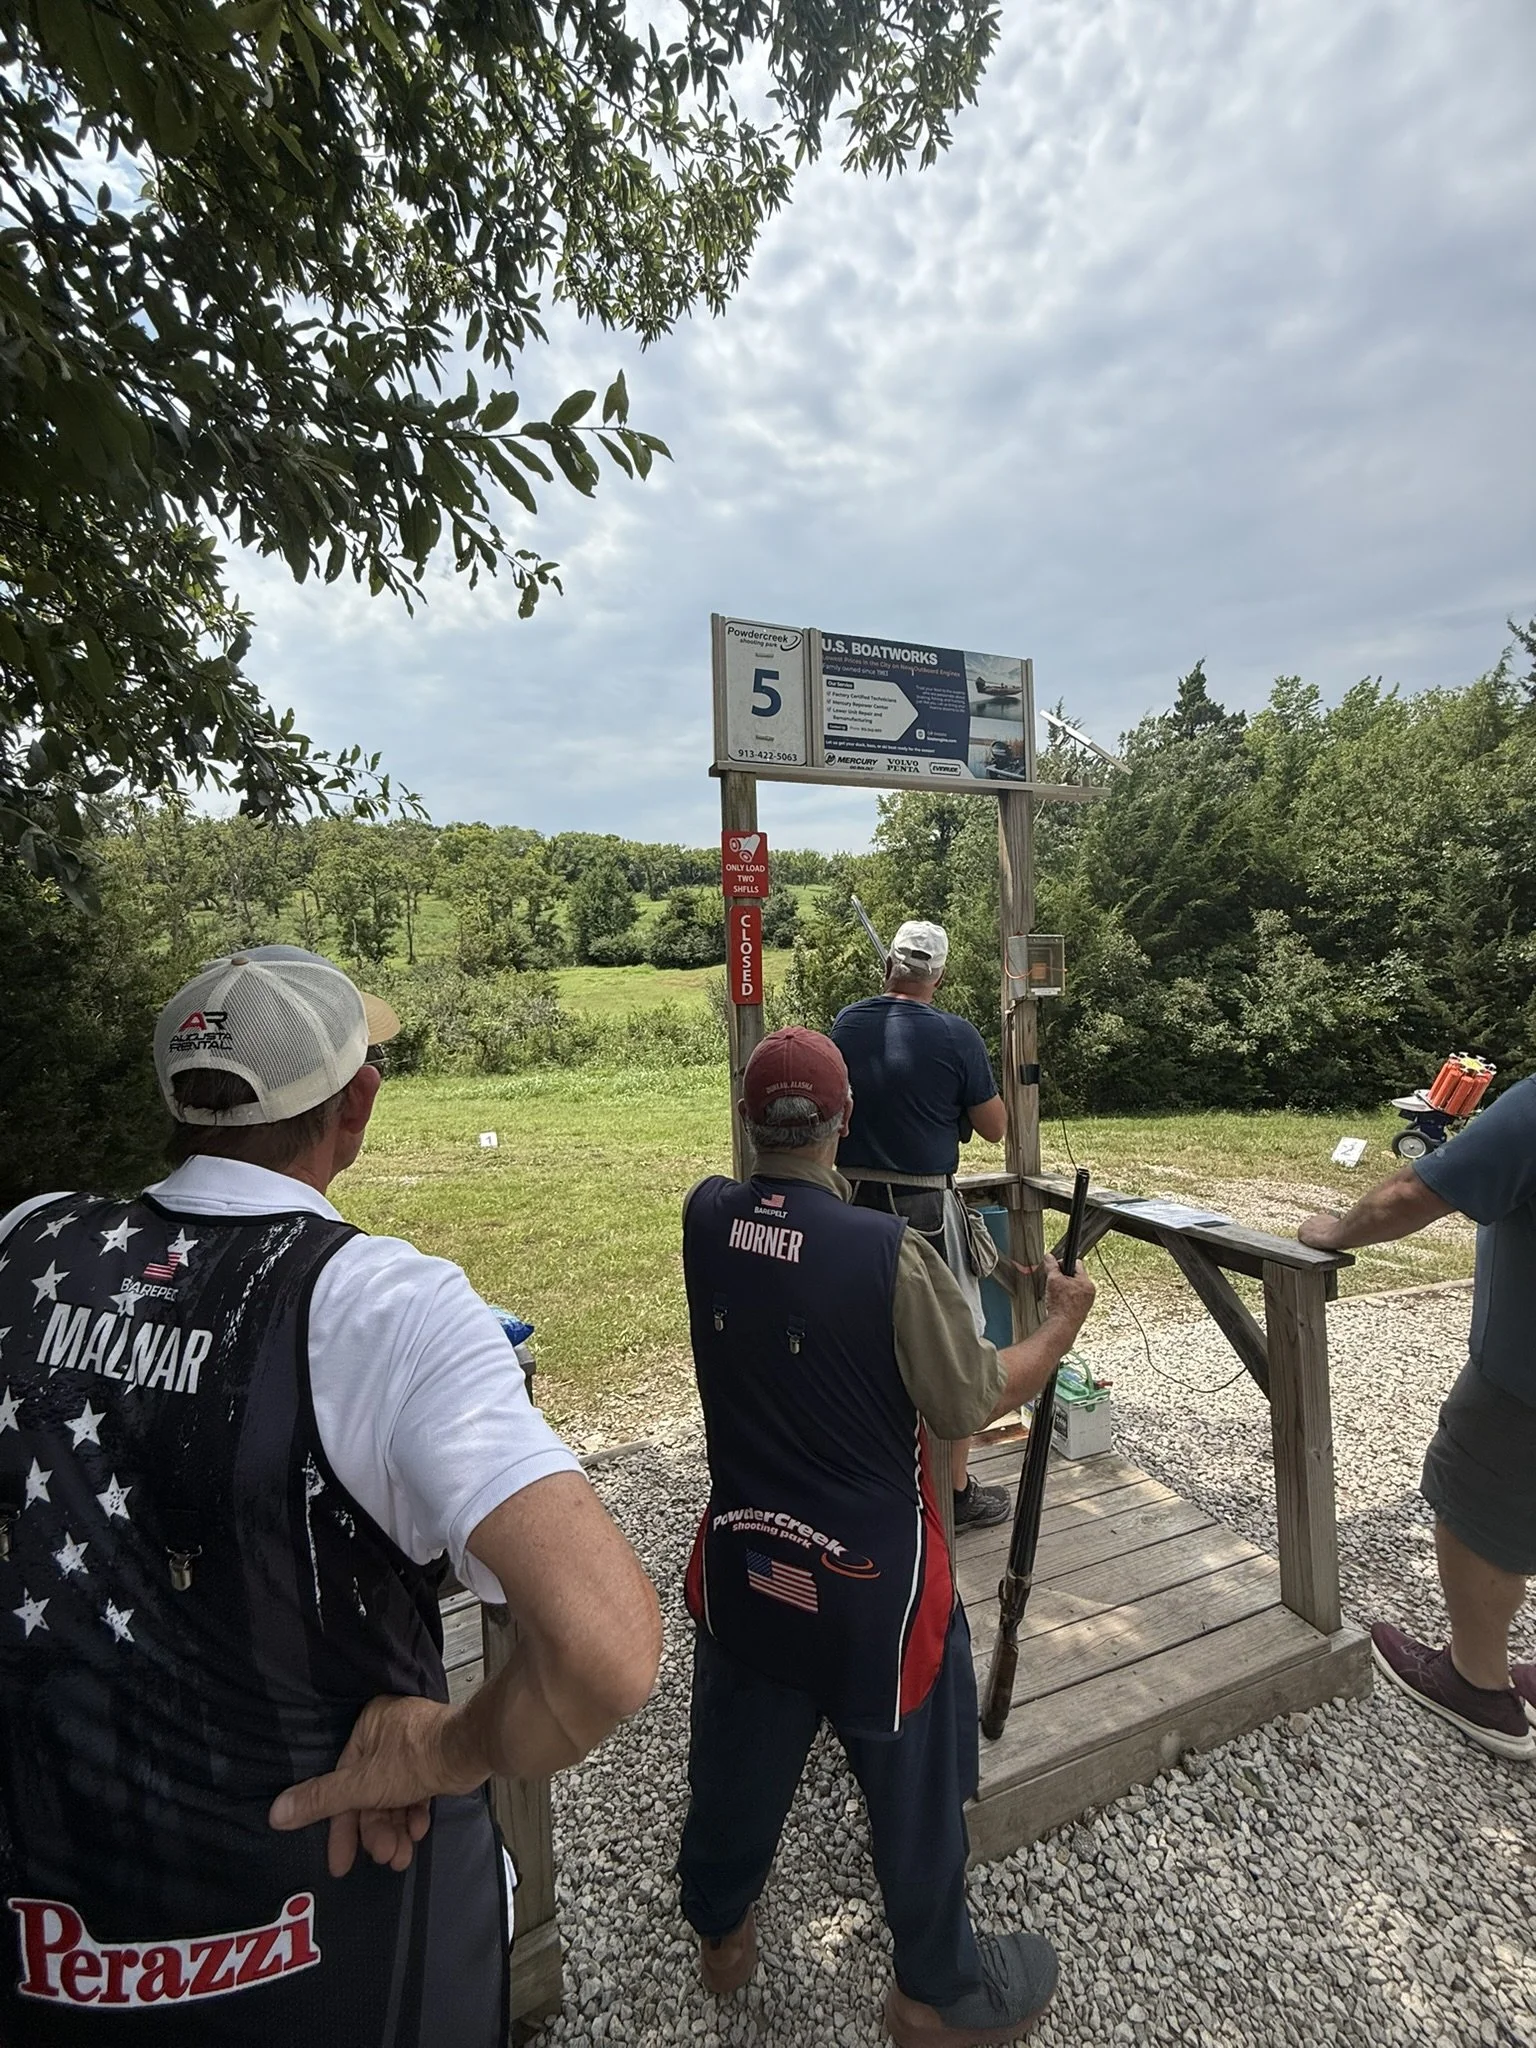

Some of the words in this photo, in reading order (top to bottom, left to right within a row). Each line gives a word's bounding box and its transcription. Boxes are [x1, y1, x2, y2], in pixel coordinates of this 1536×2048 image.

[728, 627, 788, 642] Powdercreek
[740, 638, 764, 647] shooting
[822, 638, 848, 654] U.S.
[852, 642, 938, 665] BOATWORKS
[880, 661, 890, 669] City
[752, 668, 782, 717] 5
[738, 749, 798, 762] 913-422-5063
[837, 756, 878, 766] MERCURY
[888, 758, 919, 766] VOLVO
[740, 914, 754, 996] CLOSED
[170, 1032, 232, 1042] AUGUSTA
[170, 1040, 233, 1052] RENTAL
[754, 1206, 788, 1218] BAREPELT
[728, 1218, 803, 1263] HORNER
[36, 1303, 213, 1394] MALNAR
[732, 1522, 778, 1535] shooting
[780, 1530, 812, 1549] park
[9, 1894, 320, 2005] Perazzi
